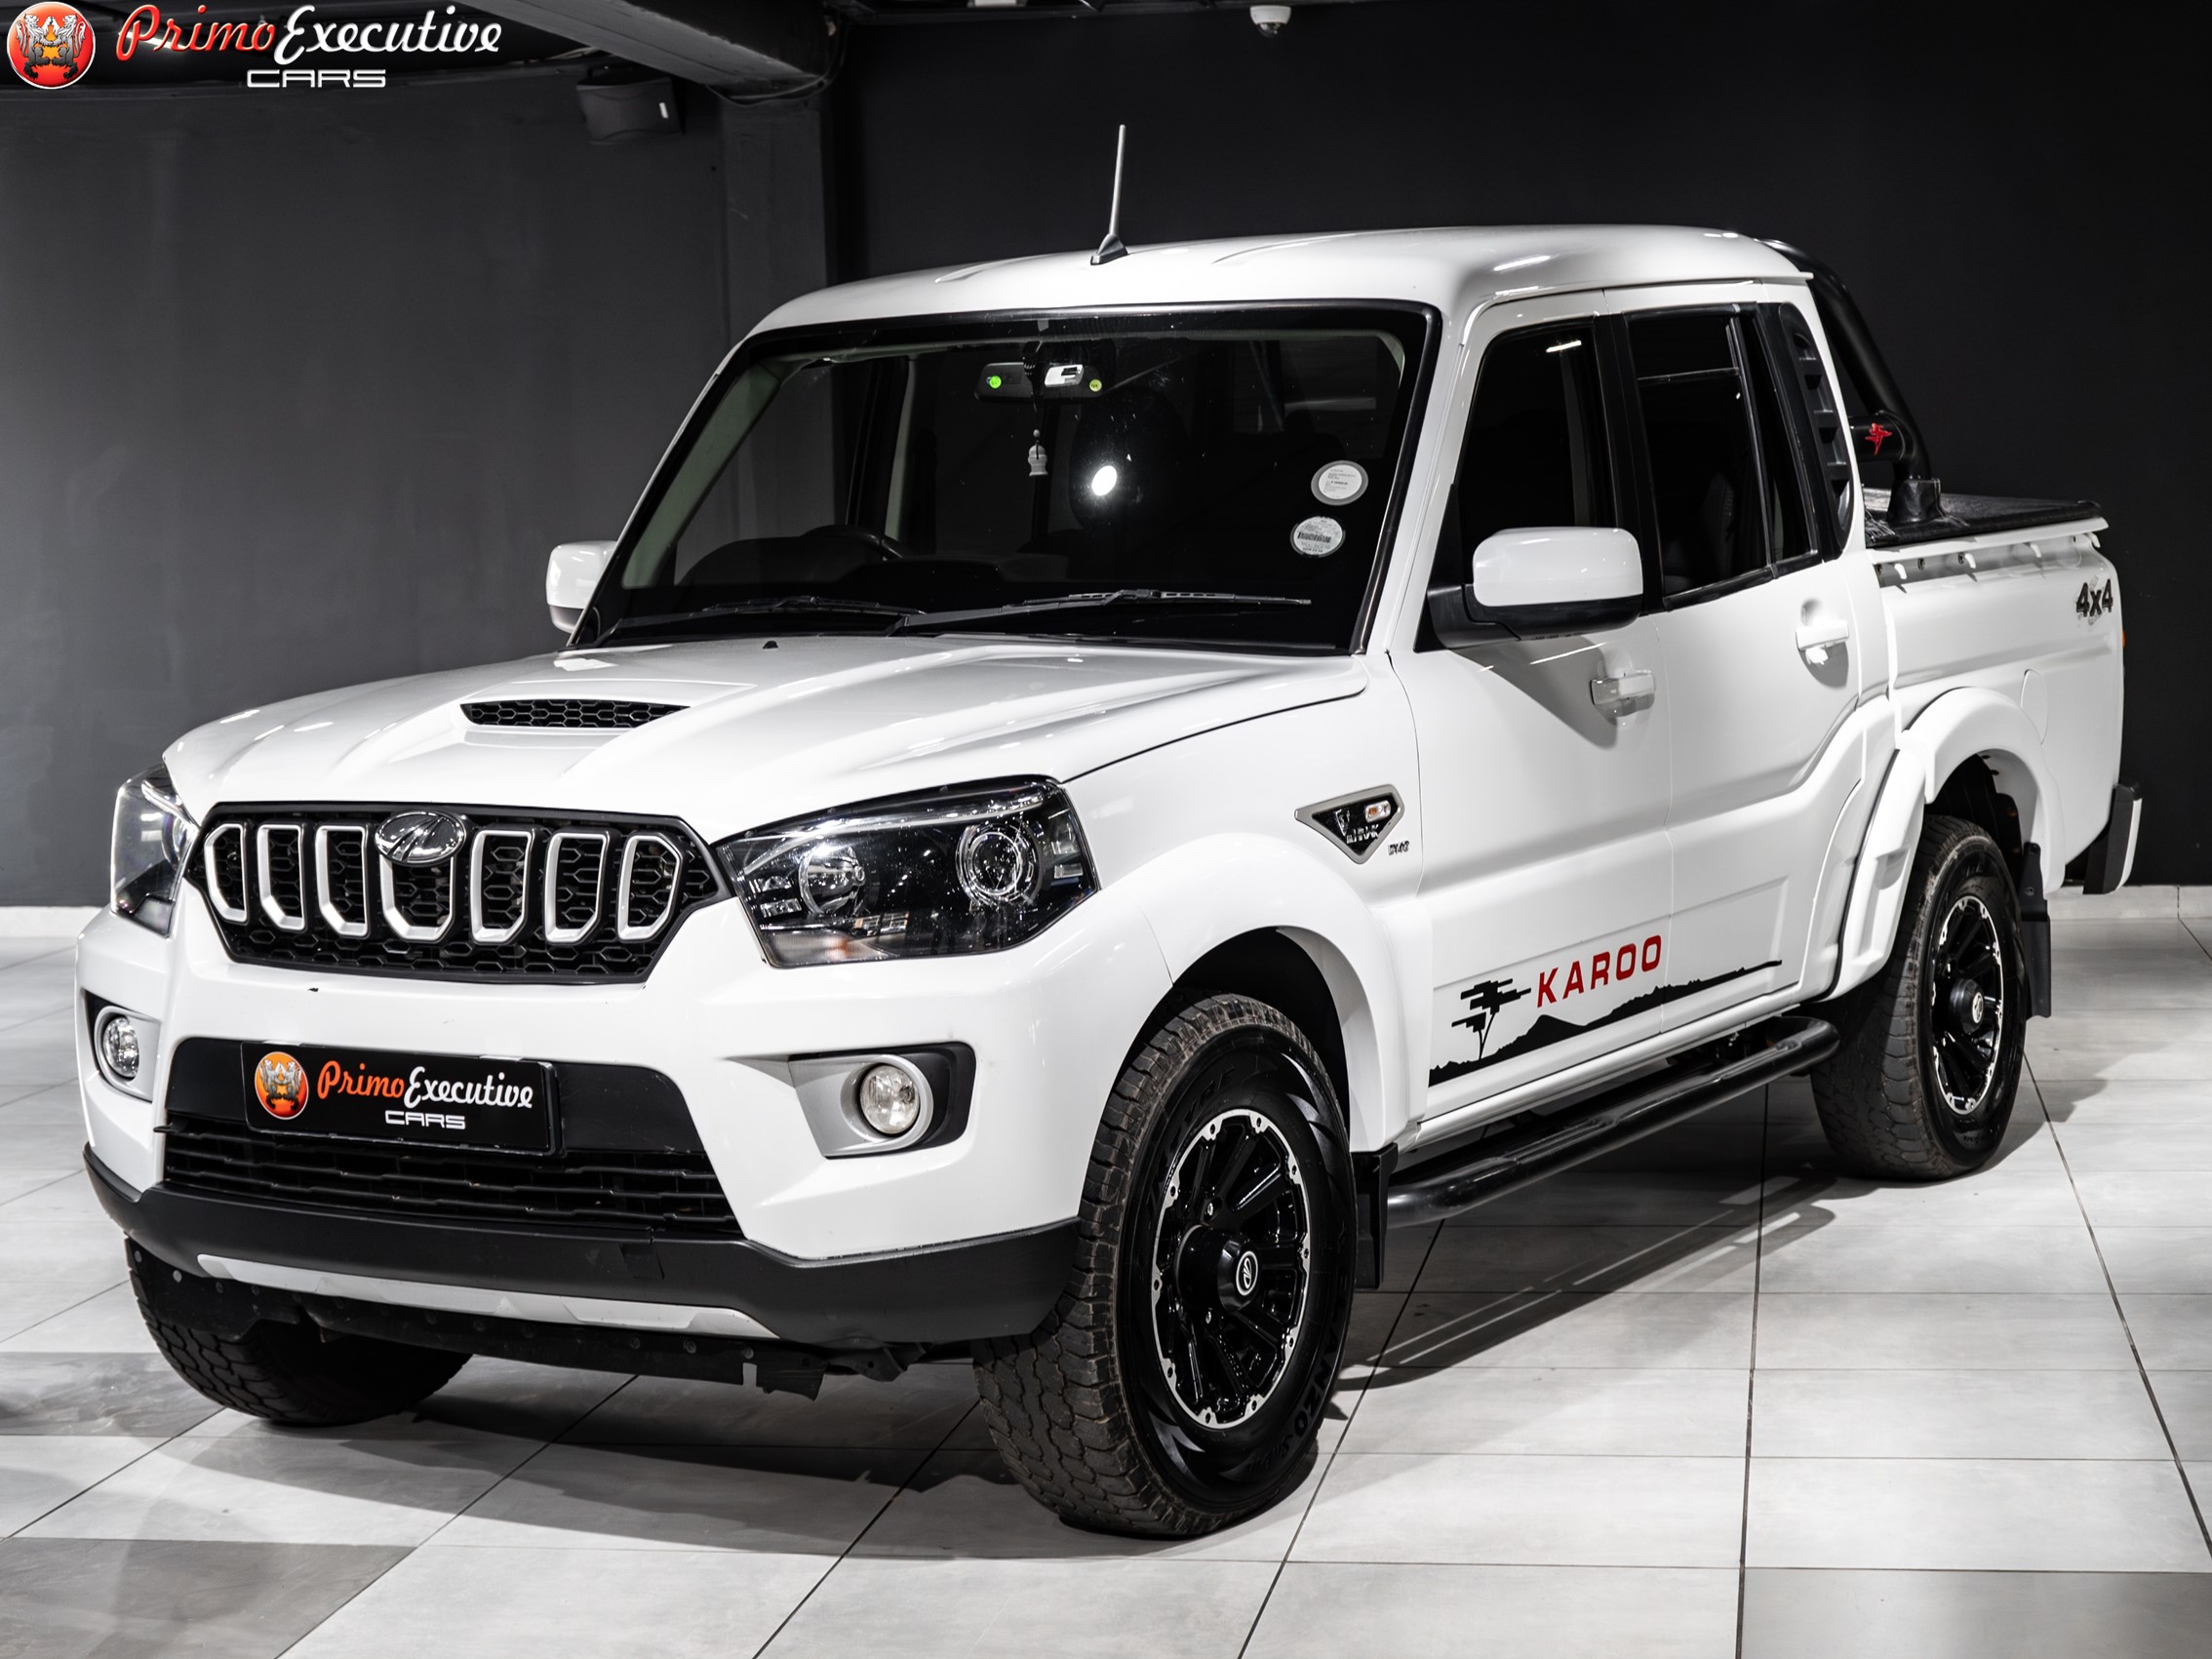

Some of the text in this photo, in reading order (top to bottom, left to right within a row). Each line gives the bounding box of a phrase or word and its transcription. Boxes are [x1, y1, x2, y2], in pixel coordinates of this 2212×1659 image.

[2075, 578, 2113, 618] 4x4
[1537, 934, 1662, 1007] KAROO
[384, 1109, 466, 1130] CARS
